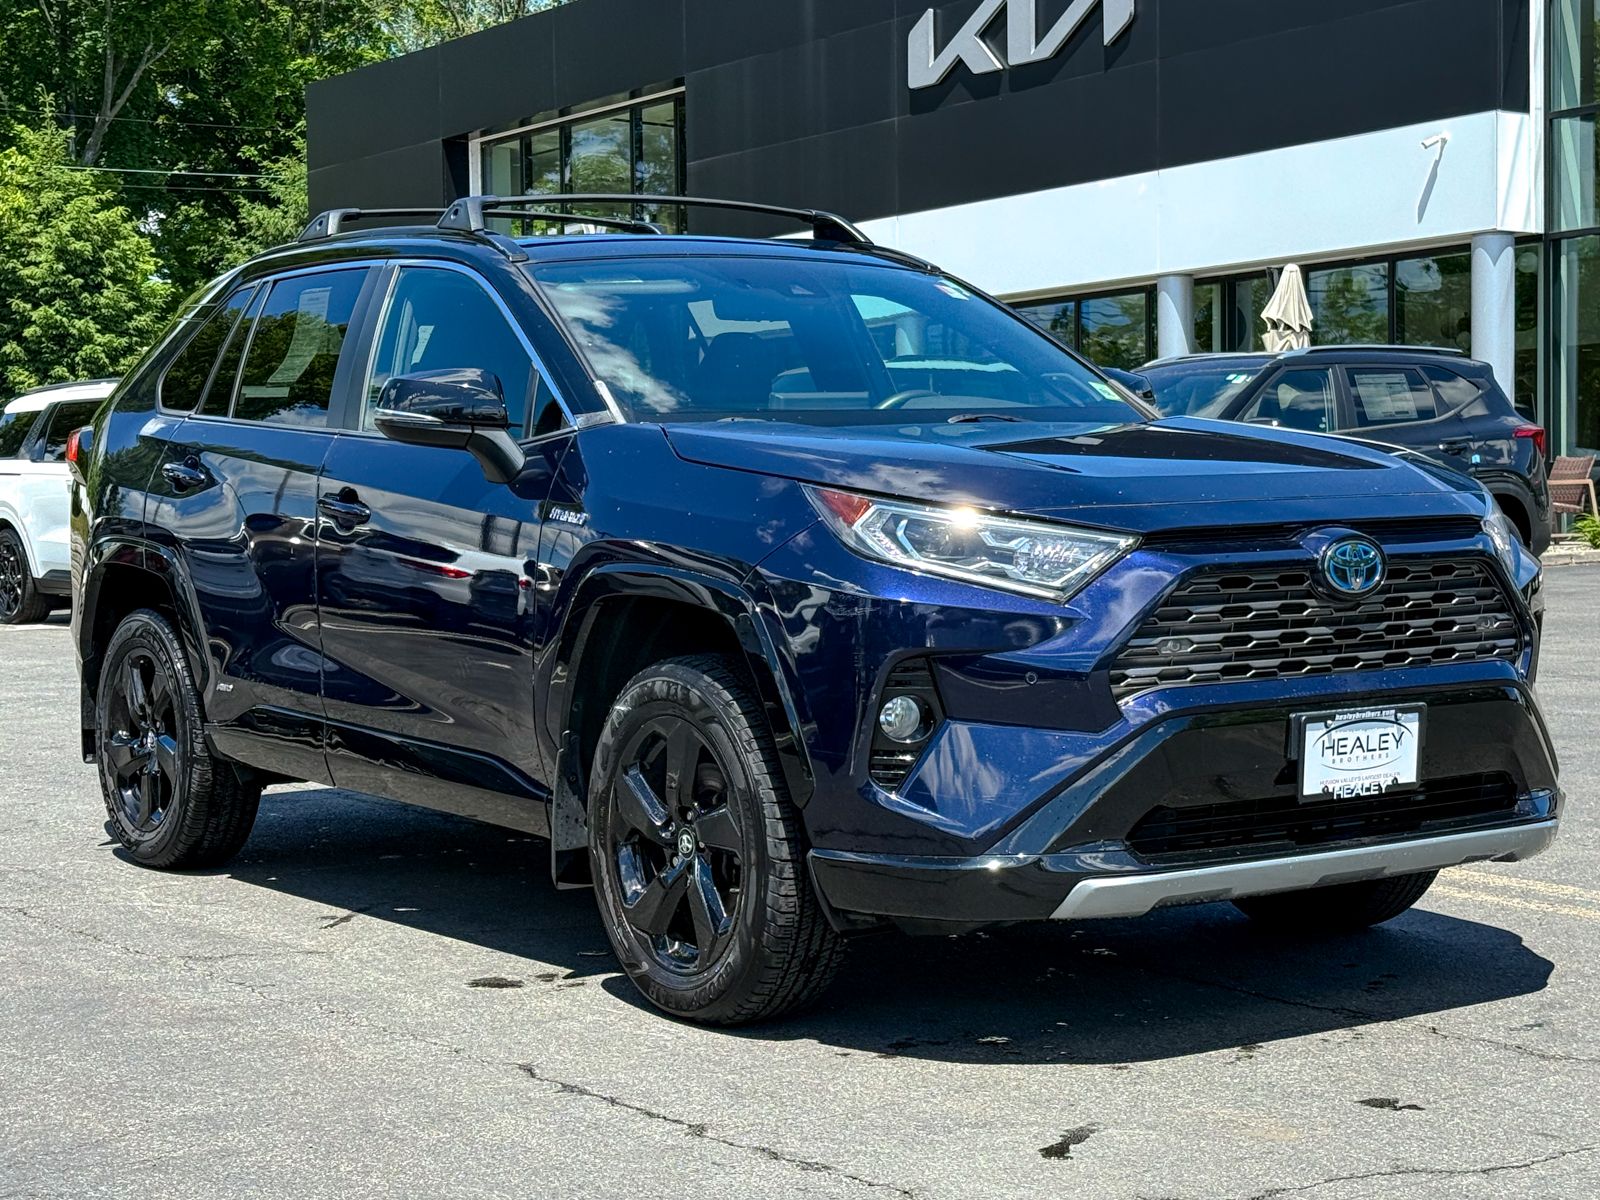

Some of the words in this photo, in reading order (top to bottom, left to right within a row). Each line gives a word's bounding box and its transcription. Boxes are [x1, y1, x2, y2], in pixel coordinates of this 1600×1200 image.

[1321, 731, 1405, 758] HEALEY
[1332, 752, 1389, 764] BROTHERS
[1333, 781, 1388, 800] HEALEY
